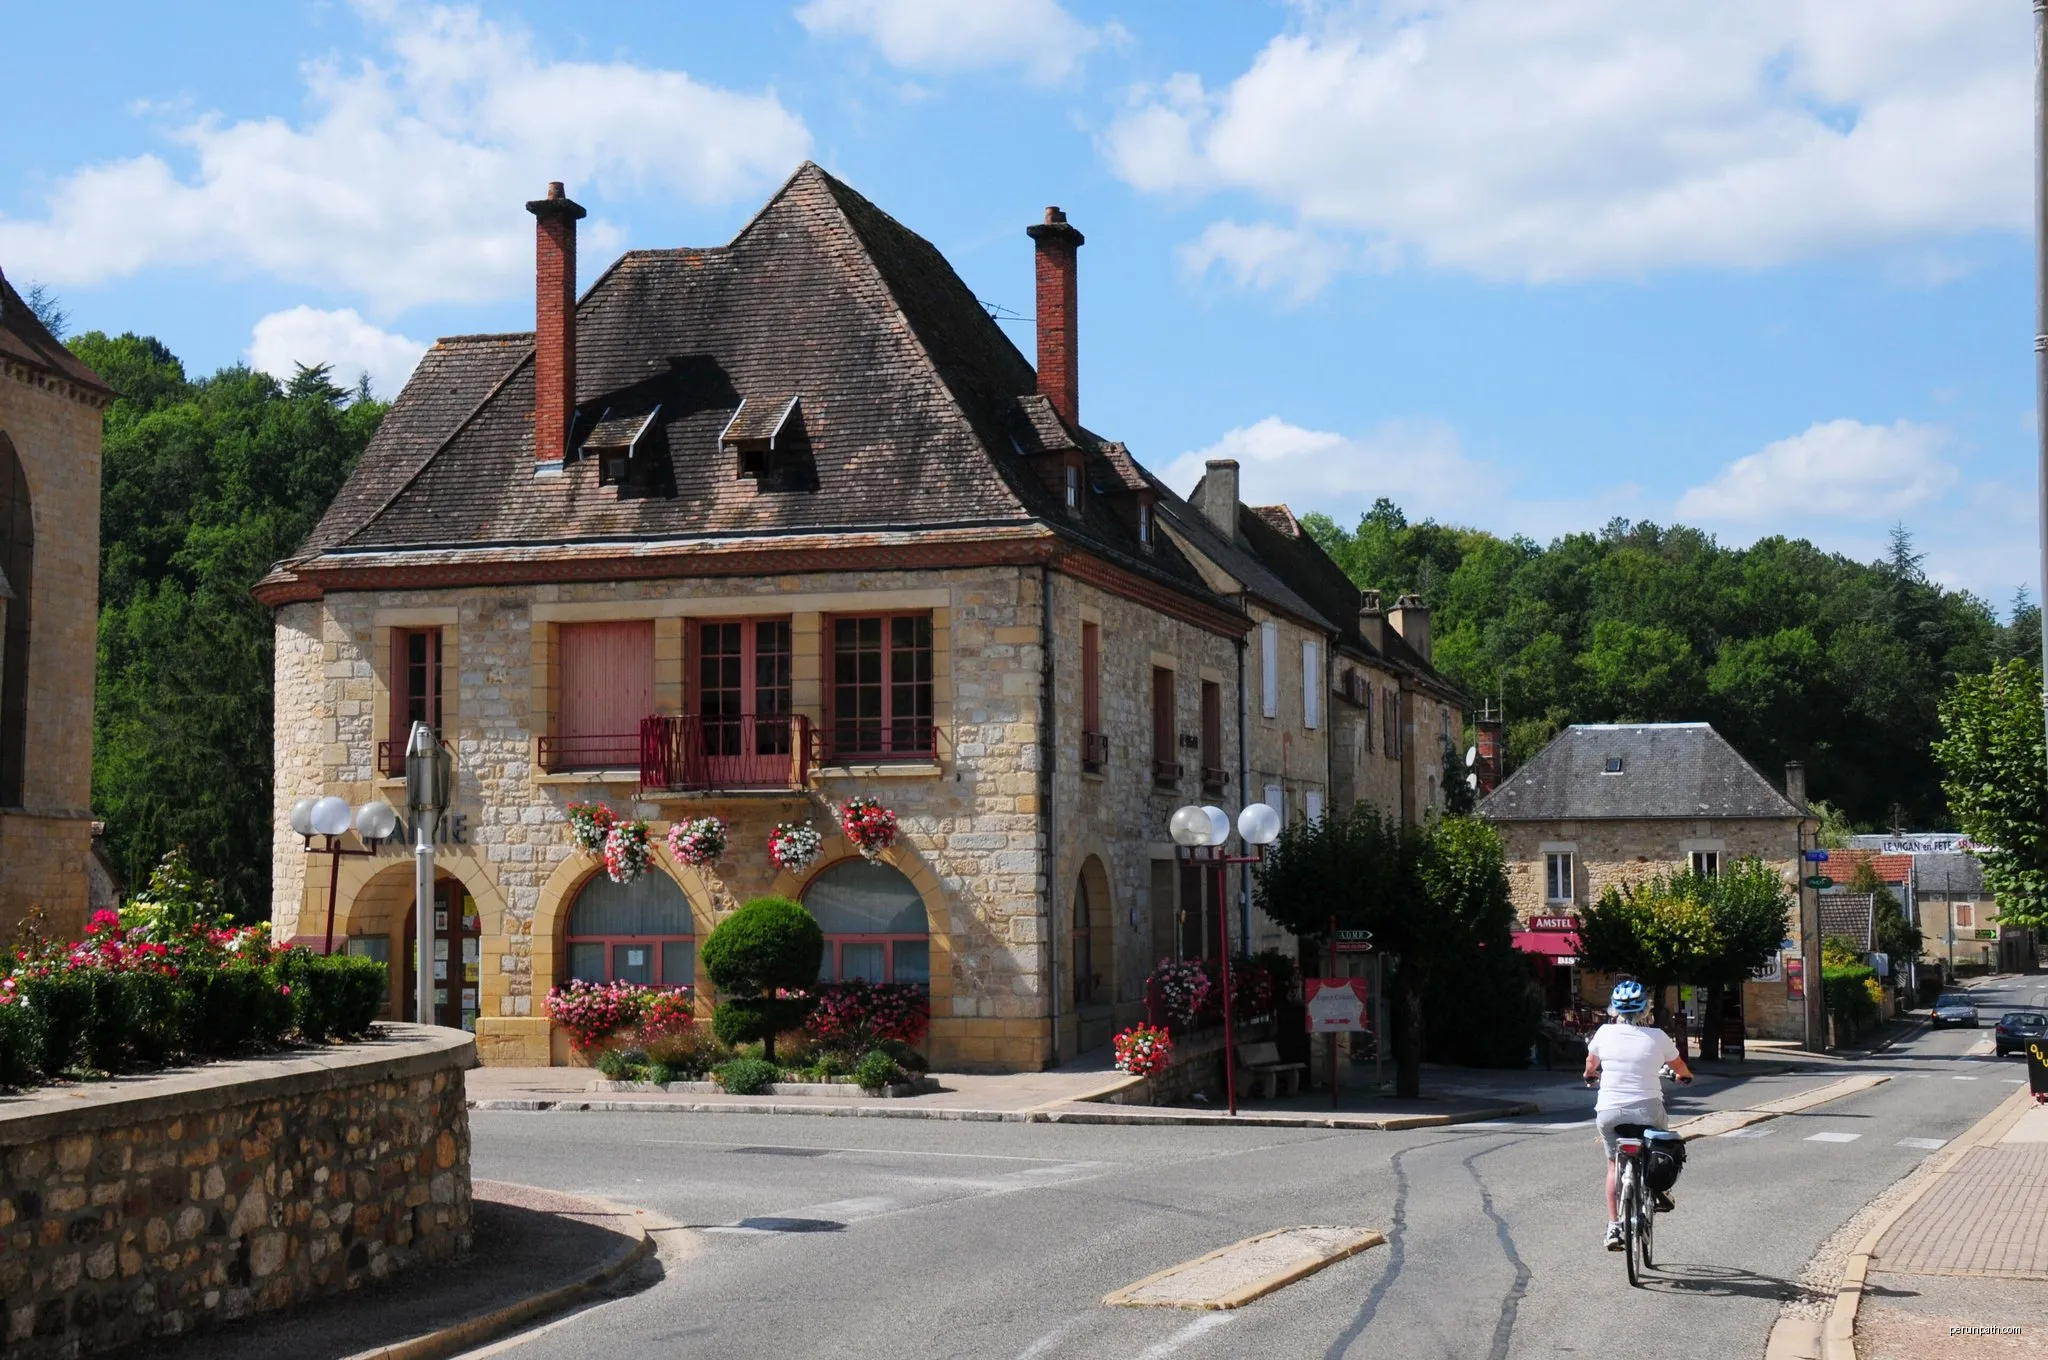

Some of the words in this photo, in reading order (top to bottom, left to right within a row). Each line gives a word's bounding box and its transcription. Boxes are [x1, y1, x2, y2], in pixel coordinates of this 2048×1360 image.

[363, 815, 467, 845] AIIE
[1883, 842, 1892, 852] LE
[1894, 841, 1920, 851] VIGAN
[1536, 918, 1572, 928] AMSTEL
[1557, 956, 1580, 965] BIS
